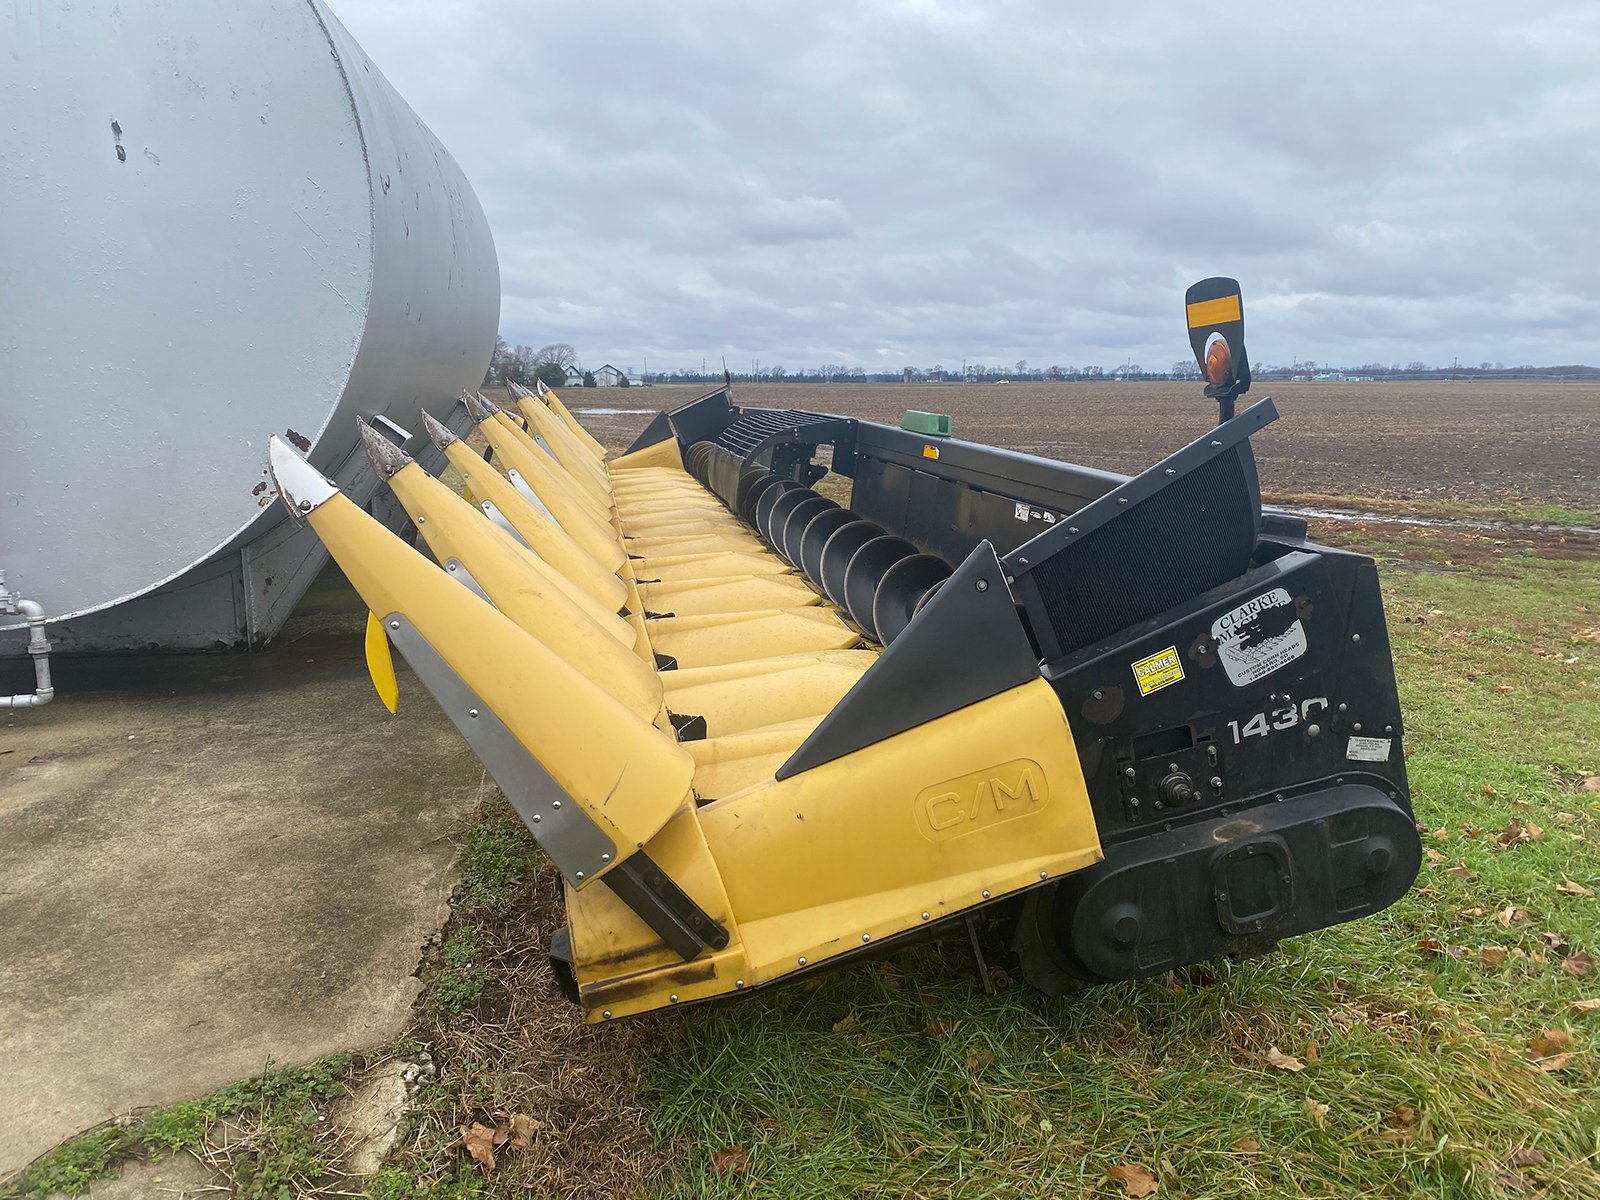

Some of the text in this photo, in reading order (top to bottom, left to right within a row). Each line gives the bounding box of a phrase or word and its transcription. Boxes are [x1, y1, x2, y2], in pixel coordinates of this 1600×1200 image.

[1220, 592, 1278, 629] CLARKE
[1137, 655, 1176, 677] CALMER
[1237, 642, 1300, 678] CUSTOM CORN HEADS
[925, 767, 1039, 832] C/M
